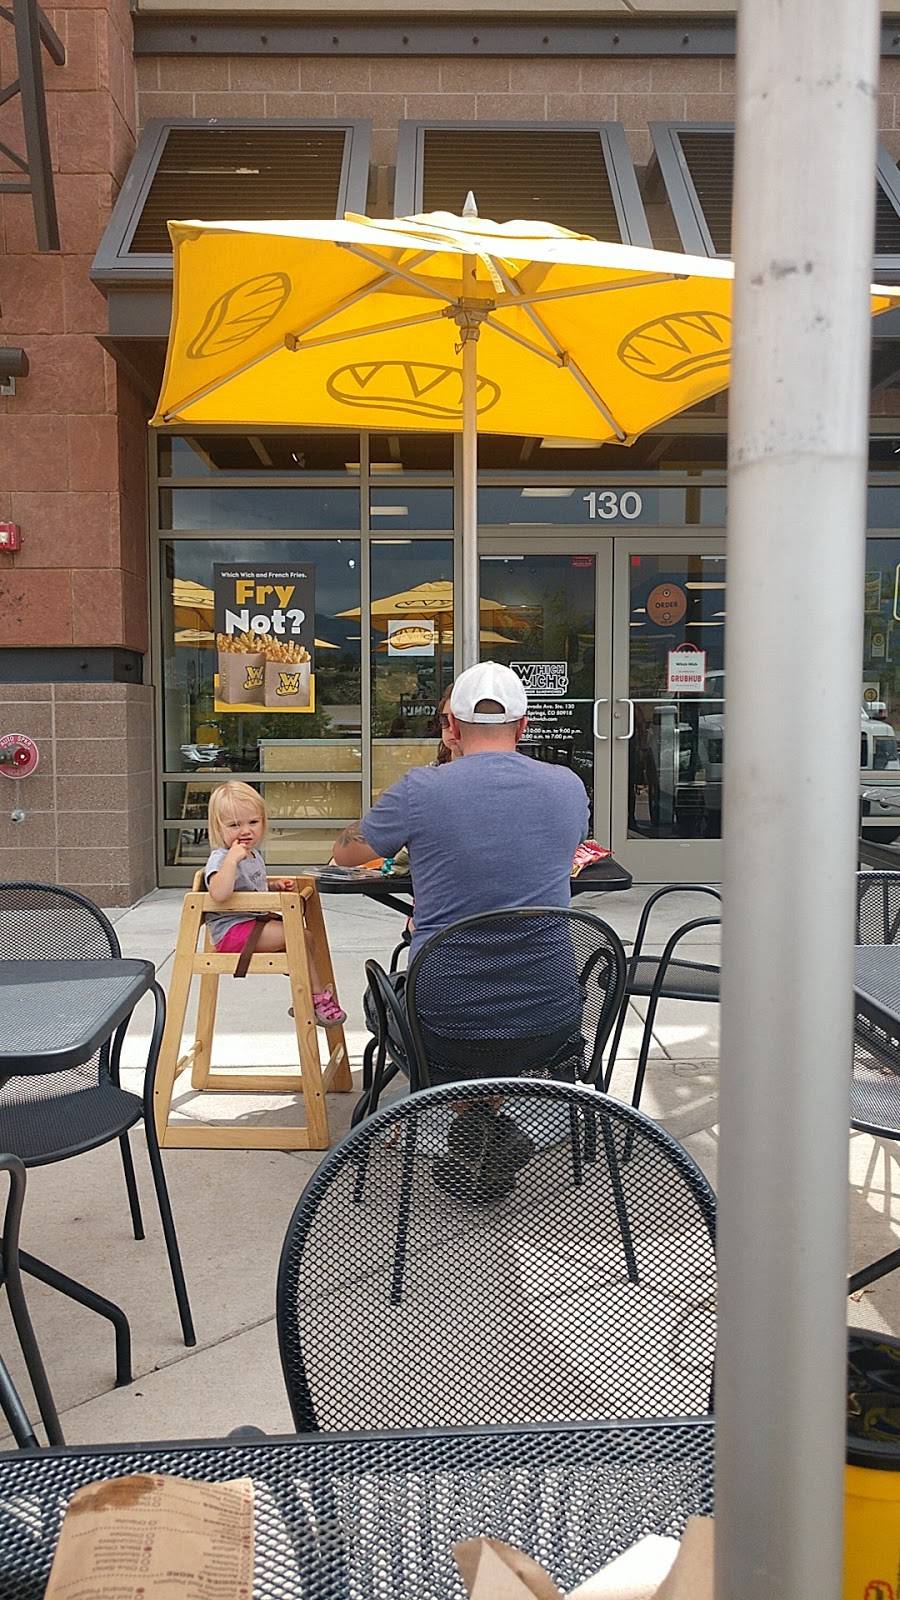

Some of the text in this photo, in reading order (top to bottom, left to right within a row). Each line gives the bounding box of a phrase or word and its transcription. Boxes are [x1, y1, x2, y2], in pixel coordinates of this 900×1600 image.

[583, 491, 643, 520] 130
[236, 580, 295, 608] Fry
[225, 609, 305, 634] Not?
[511, 664, 565, 680] WHICH
[671, 674, 702, 682] GRUBHUB
[0, 736, 14, 746] AUTO
